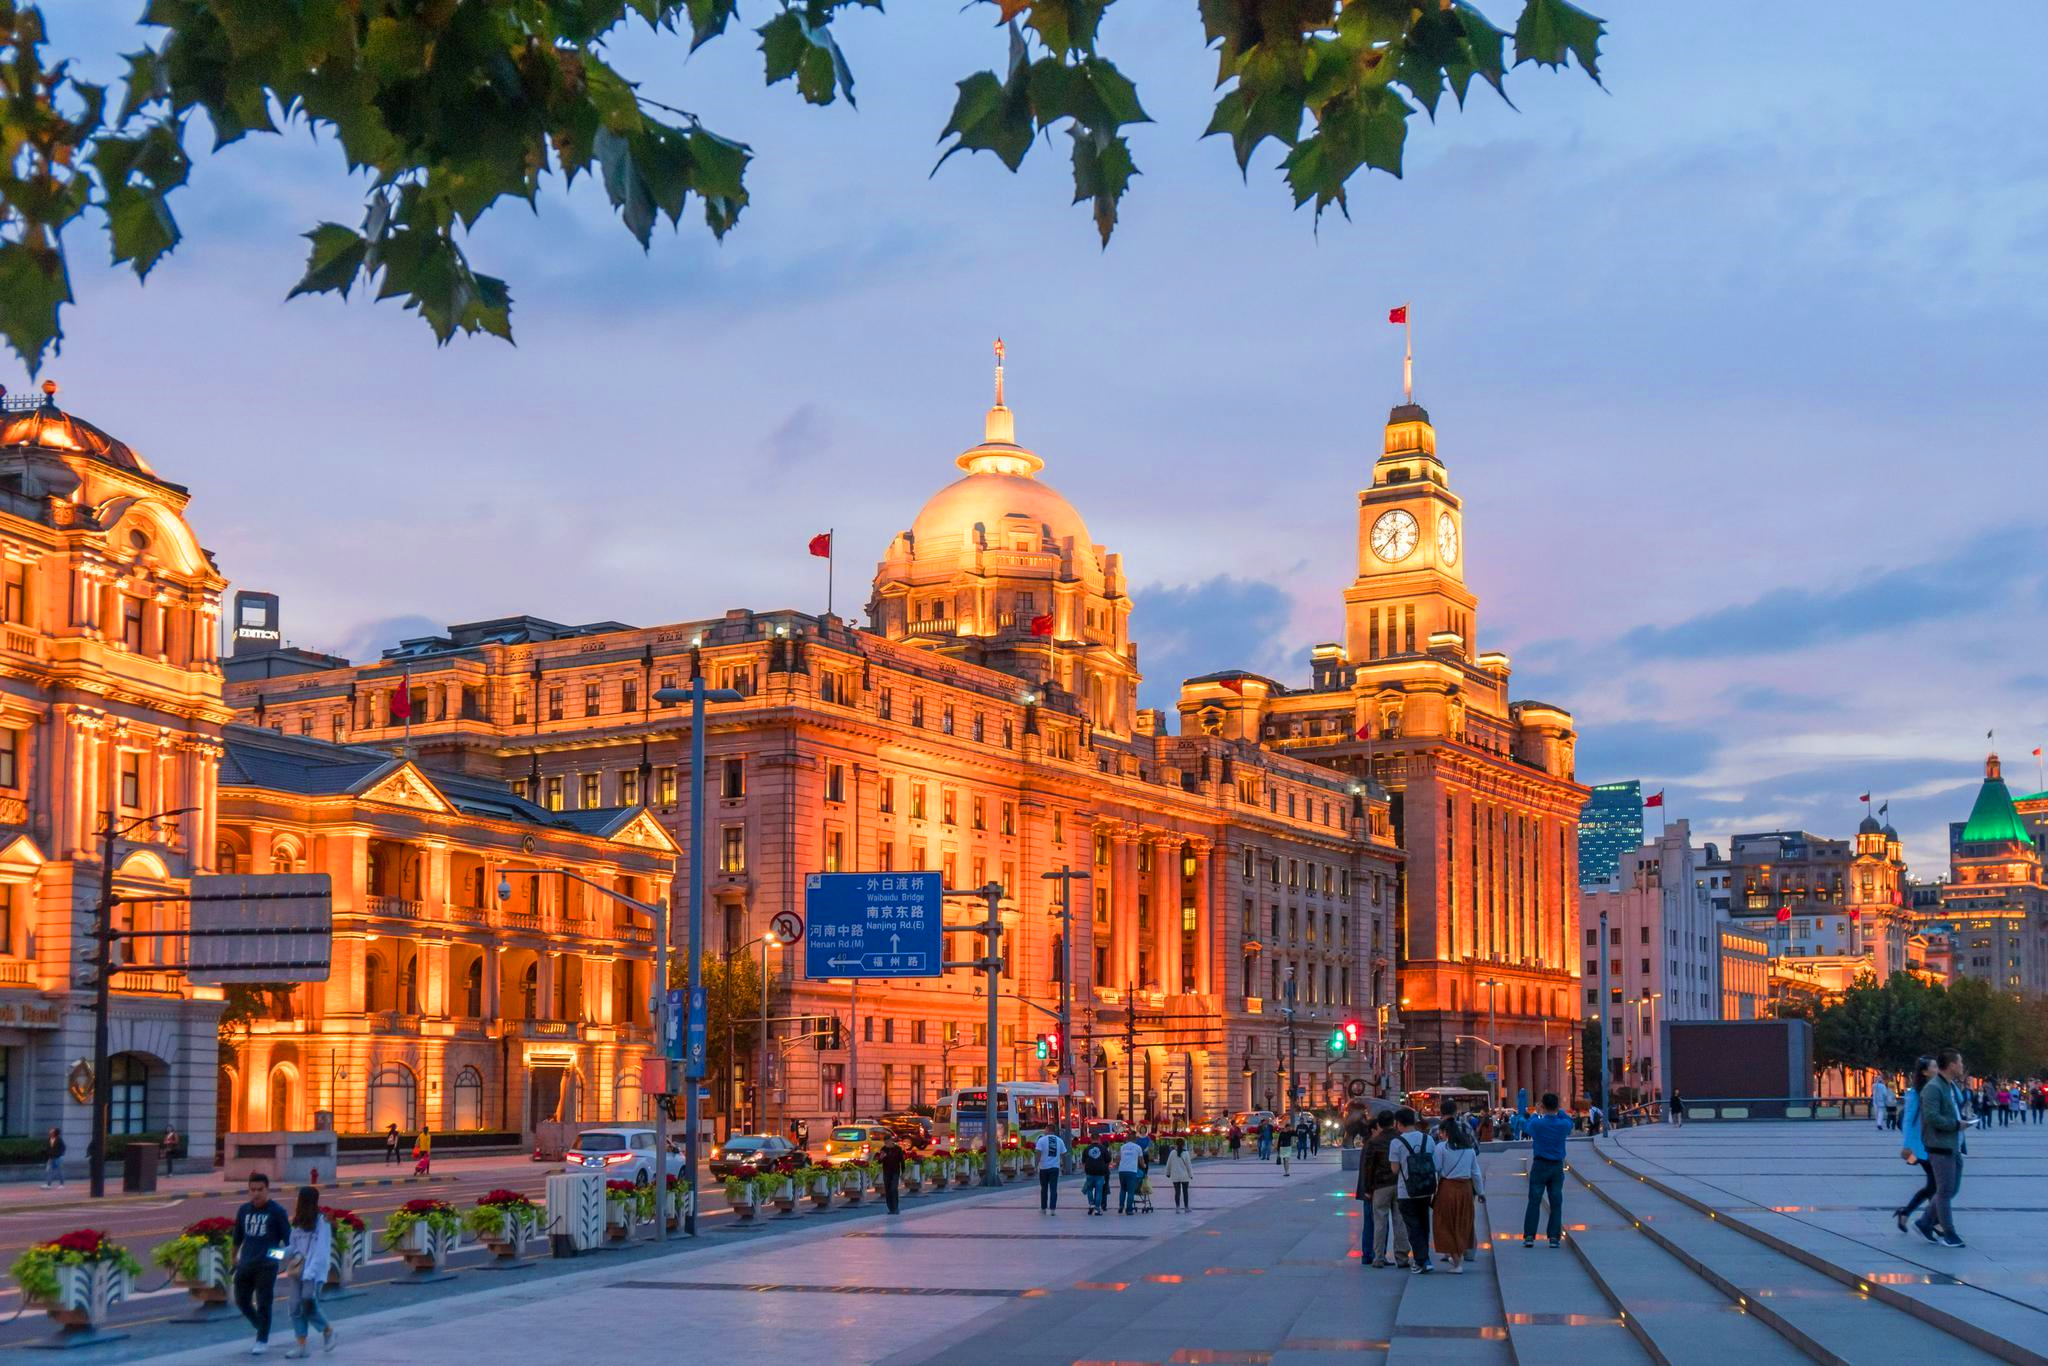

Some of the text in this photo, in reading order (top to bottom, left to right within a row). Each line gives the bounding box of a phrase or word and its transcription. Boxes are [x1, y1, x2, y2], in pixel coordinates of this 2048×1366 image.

[239, 628, 279, 639] EDITION
[867, 877, 924, 891] 外白渡桥
[867, 893, 925, 903] Waibaidu Bridge
[867, 905, 924, 919] 南京东路
[810, 924, 864, 938] 河南中路
[866, 920, 925, 931] Nanjing Rd.(E)
[810, 939, 865, 950] Henan Rd.(M)
[873, 956, 919, 968] 福州路
[244, 1213, 269, 1225] EASY
[244, 1224, 267, 1237] LIFE
